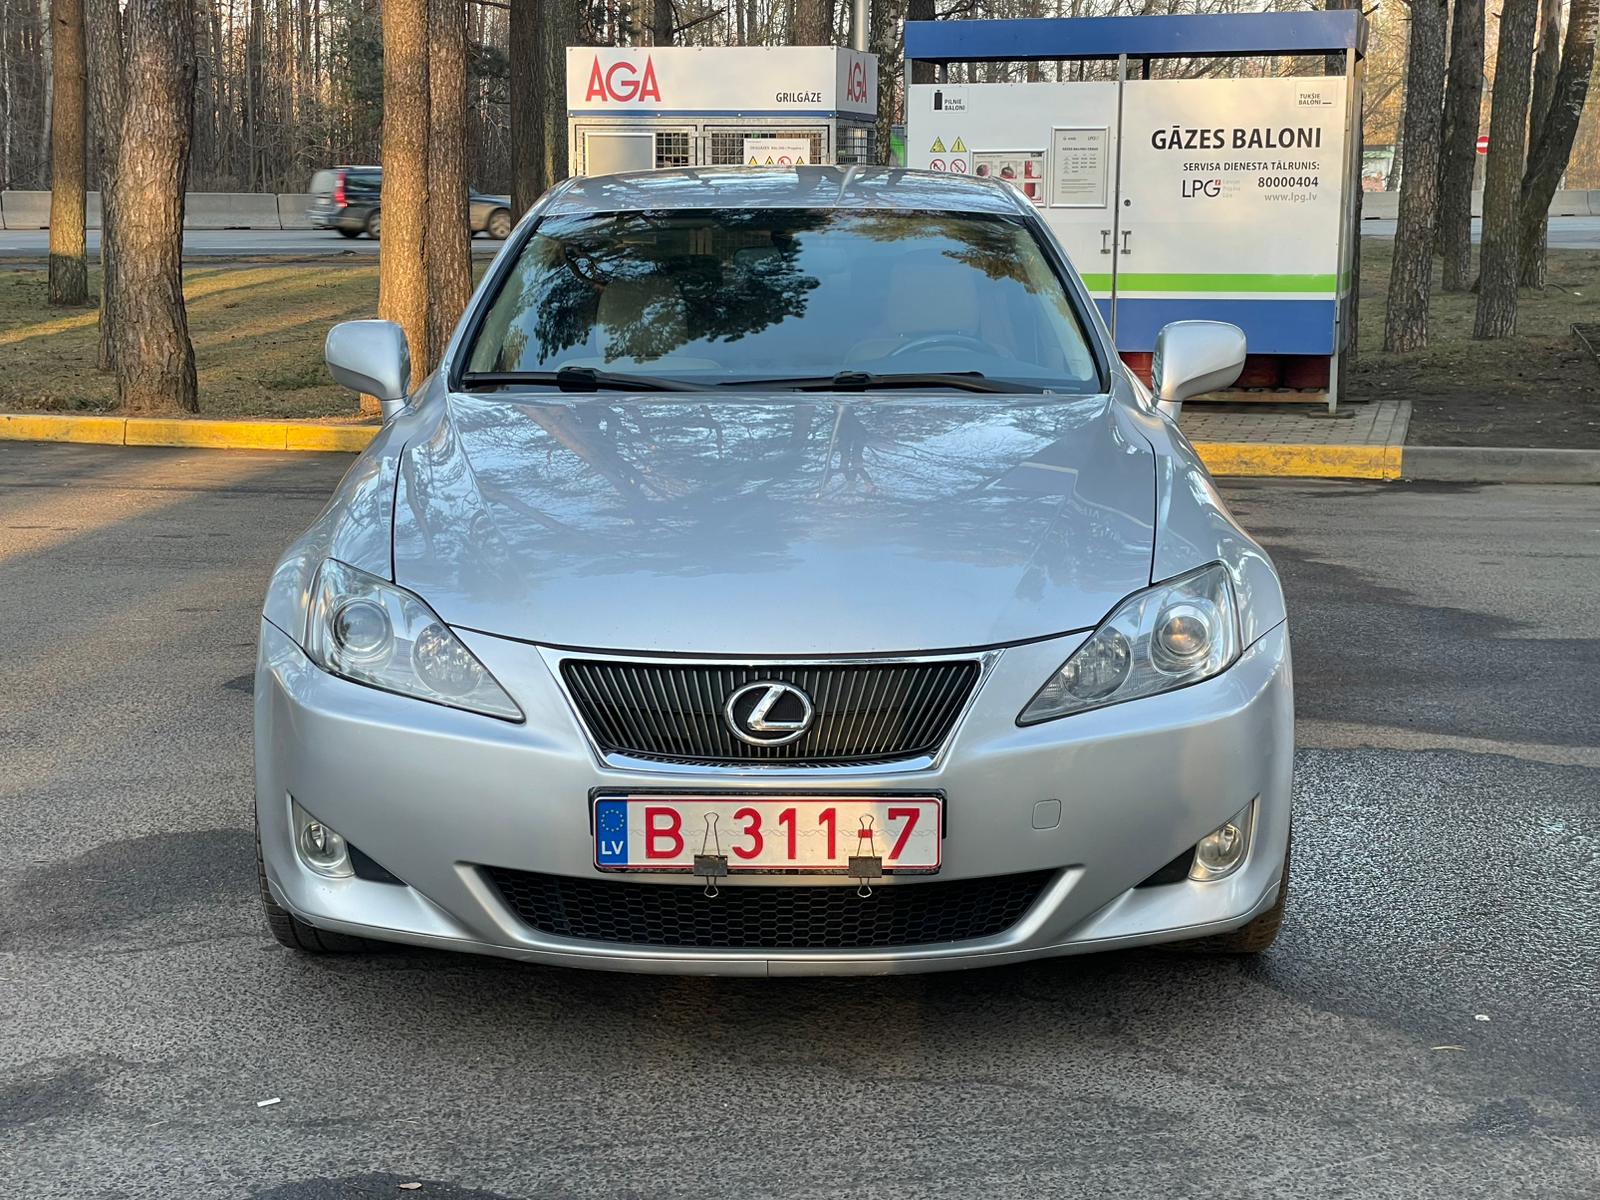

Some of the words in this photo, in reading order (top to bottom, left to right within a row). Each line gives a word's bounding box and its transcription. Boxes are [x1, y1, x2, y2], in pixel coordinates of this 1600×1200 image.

[586, 54, 661, 102] AGA
[847, 55, 868, 103] AGA
[1151, 126, 1225, 150] GĀZES
[1232, 127, 1321, 149] BALONI
[1183, 162, 1221, 171] SERVISA
[1223, 161, 1268, 171] DIENESTA
[1182, 180, 1221, 198] LPG
[1258, 177, 1319, 188] 80000404
[1265, 192, 1317, 203] www.lpg.lv
[645, 807, 685, 860] B
[601, 841, 624, 855] LV
